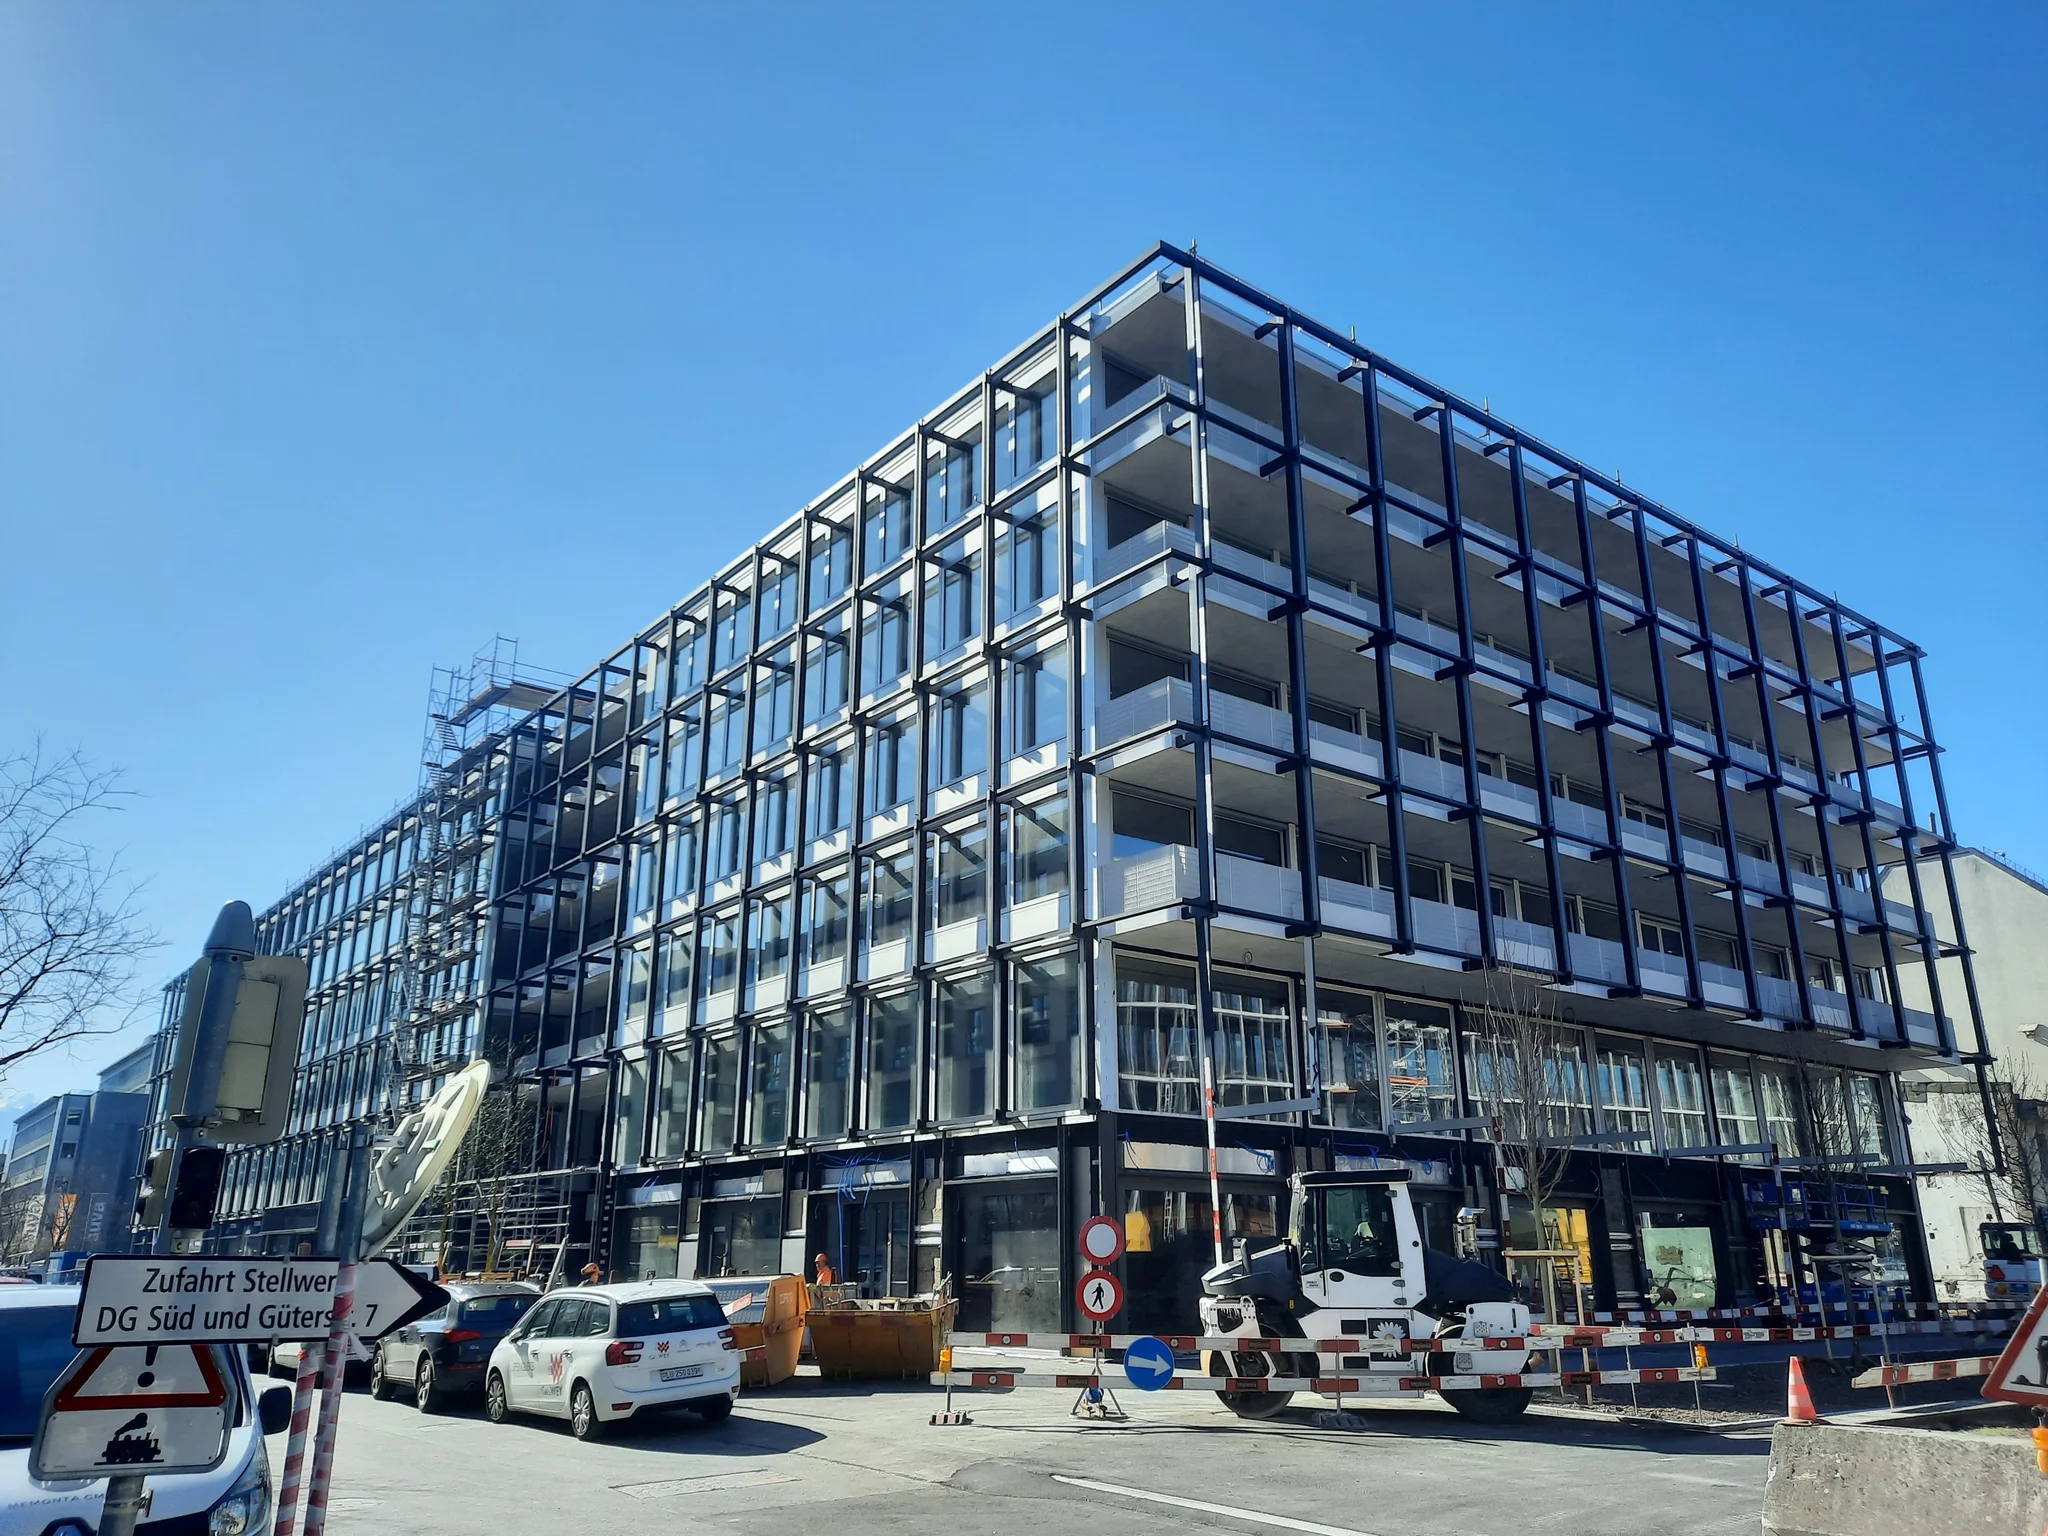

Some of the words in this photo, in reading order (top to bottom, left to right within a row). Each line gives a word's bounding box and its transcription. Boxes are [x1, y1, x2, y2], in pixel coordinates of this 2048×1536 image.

[142, 1266, 236, 1293] Zufahrt
[243, 1267, 337, 1293] Stellwer
[96, 1306, 138, 1332] DG
[147, 1304, 196, 1331] Süd
[203, 1304, 251, 1330] und
[259, 1304, 356, 1329] Güters.
[365, 1304, 378, 1327] 7
[8, 1495, 79, 1509] MEMONTA
